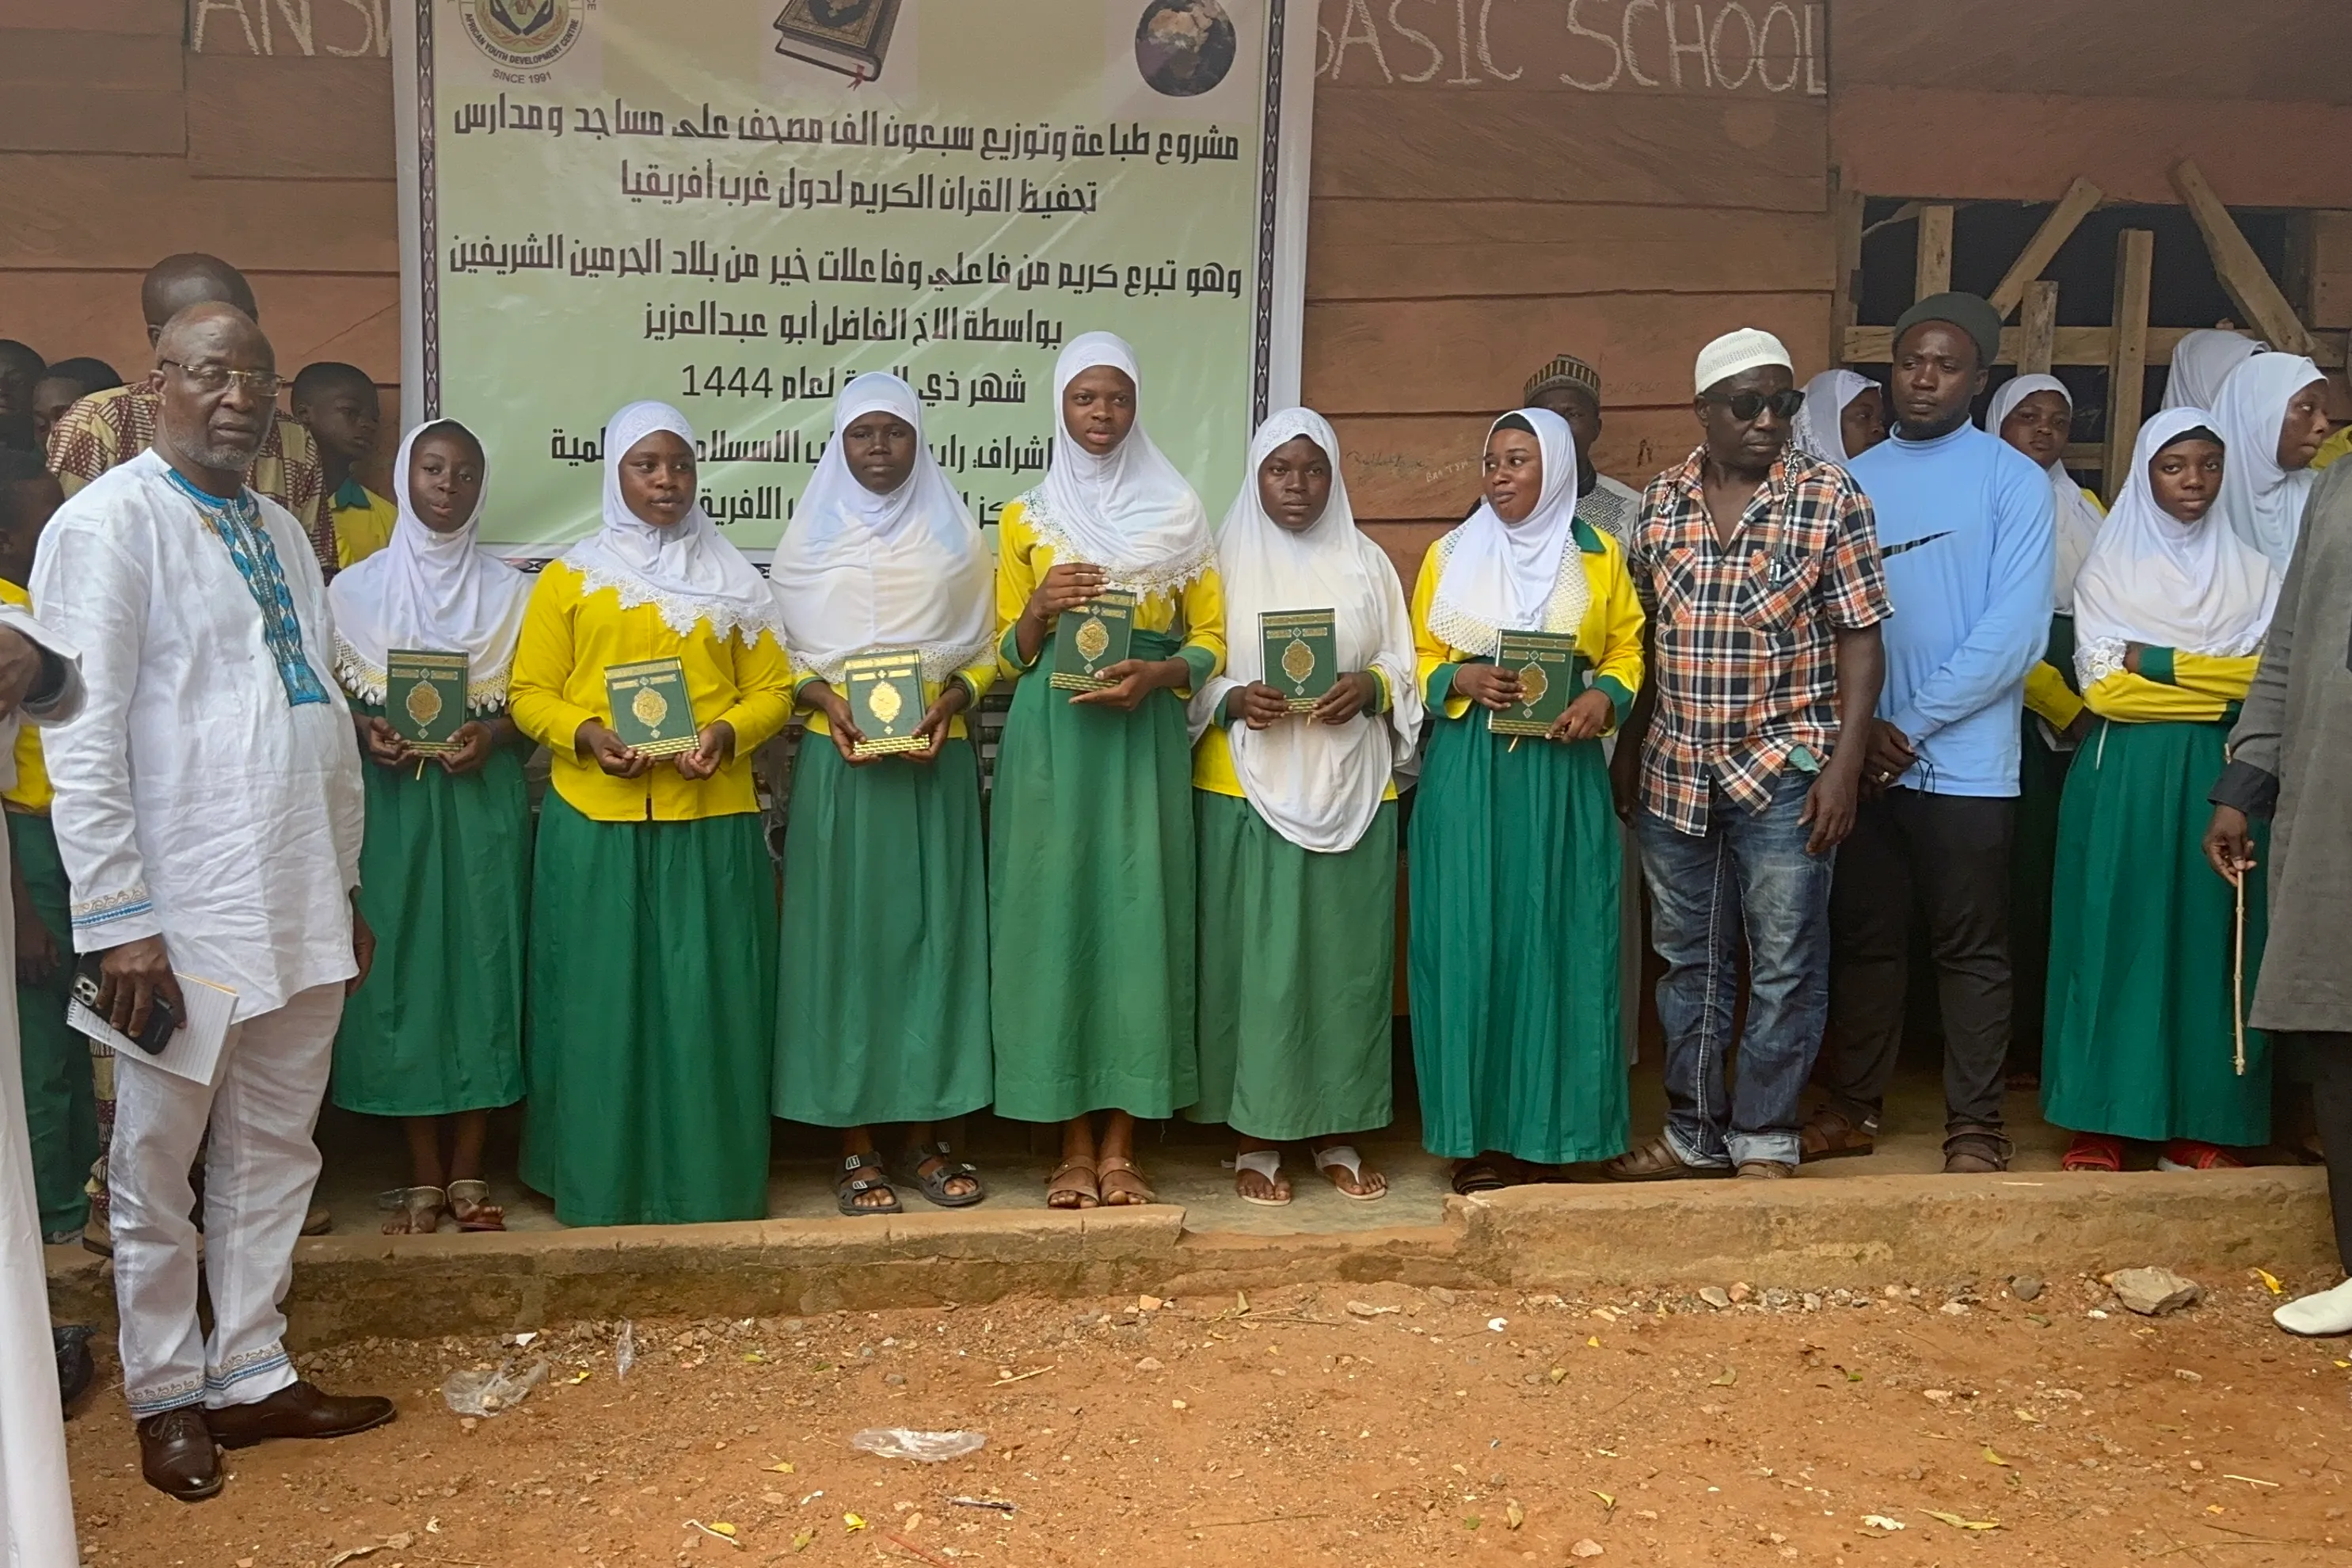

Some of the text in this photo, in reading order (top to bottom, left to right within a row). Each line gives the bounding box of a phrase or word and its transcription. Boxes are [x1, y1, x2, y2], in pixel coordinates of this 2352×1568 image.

[193, 0, 391, 57] ANS
[465, 13, 579, 65] AFRICAN YOUTH DEVELOPMENT CENTRE
[1558, 0, 1827, 94] SCHOOL
[492, 68, 552, 84] SINCE 1991
[454, 92, 1239, 165] مشروع طباعة وتوزيع سبعون الف مصحف على مساجد ومدارس
[621, 158, 1098, 220] تحفيظ القران الكريم لدول غرب أفريقيا
[449, 232, 1243, 299] وهو تبرع كريم من فاعلي وفاعلات خير من بلاد الحرمين الشريفين
[779, 299, 817, 346] أبو
[822, 305, 908, 346] الفاضل
[911, 306, 958, 347] الاخ
[963, 306, 1063, 350] بواسطة
[682, 364, 774, 399] 1444
[782, 365, 835, 402] لعام
[918, 370, 960, 407] ذي
[967, 367, 1026, 408] شهر
